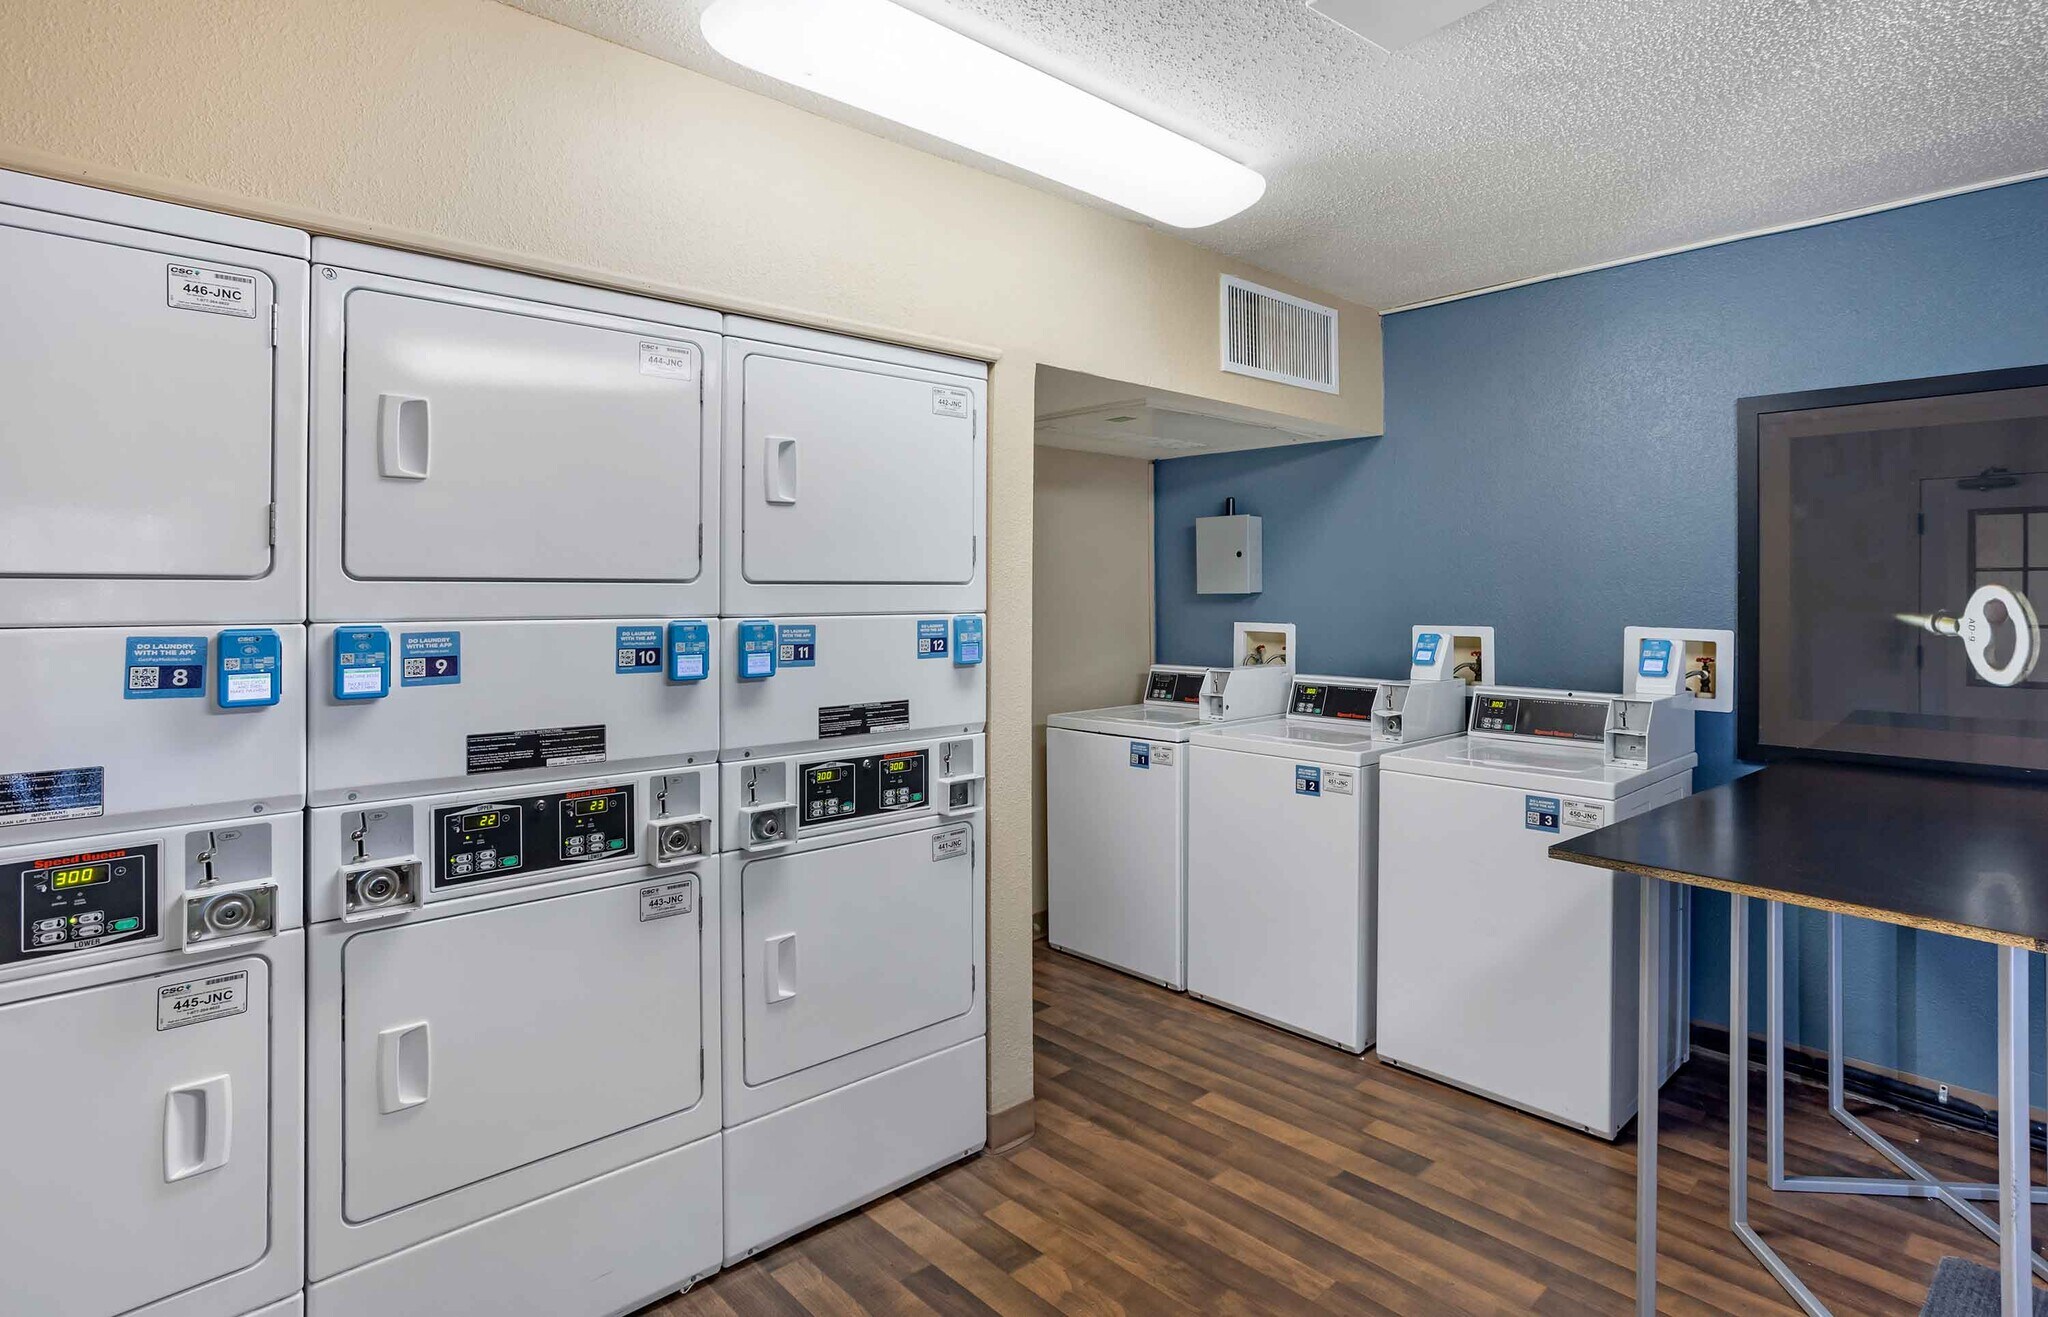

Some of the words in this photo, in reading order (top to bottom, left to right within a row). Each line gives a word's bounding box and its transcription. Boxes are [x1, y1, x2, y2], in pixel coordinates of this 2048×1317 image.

[170, 267, 193, 275] CSC
[183, 284, 242, 300] 446-JNC
[648, 356, 683, 367] 444-JNC
[938, 399, 962, 407] 442-JNC
[933, 639, 944, 650] 12
[639, 651, 656, 664] 10
[798, 646, 808, 658] 11
[435, 659, 448, 674] 9
[172, 669, 188, 686] 8
[1309, 782, 1315, 790] 2
[566, 790, 590, 799] Speed
[590, 800, 604, 811] 23
[480, 814, 496, 826] 22
[1545, 816, 1552, 825] 3
[1569, 811, 1598, 820] 450-JNC
[938, 840, 962, 849] 441-JNC
[34, 854, 80, 869] Speed
[82, 850, 126, 861] Queen
[56, 868, 93, 886] 300
[649, 895, 683, 907] 443-JNC
[74, 939, 101, 948] LOWER
[161, 986, 184, 995] CSC
[173, 990, 233, 1010] 445-JNC
